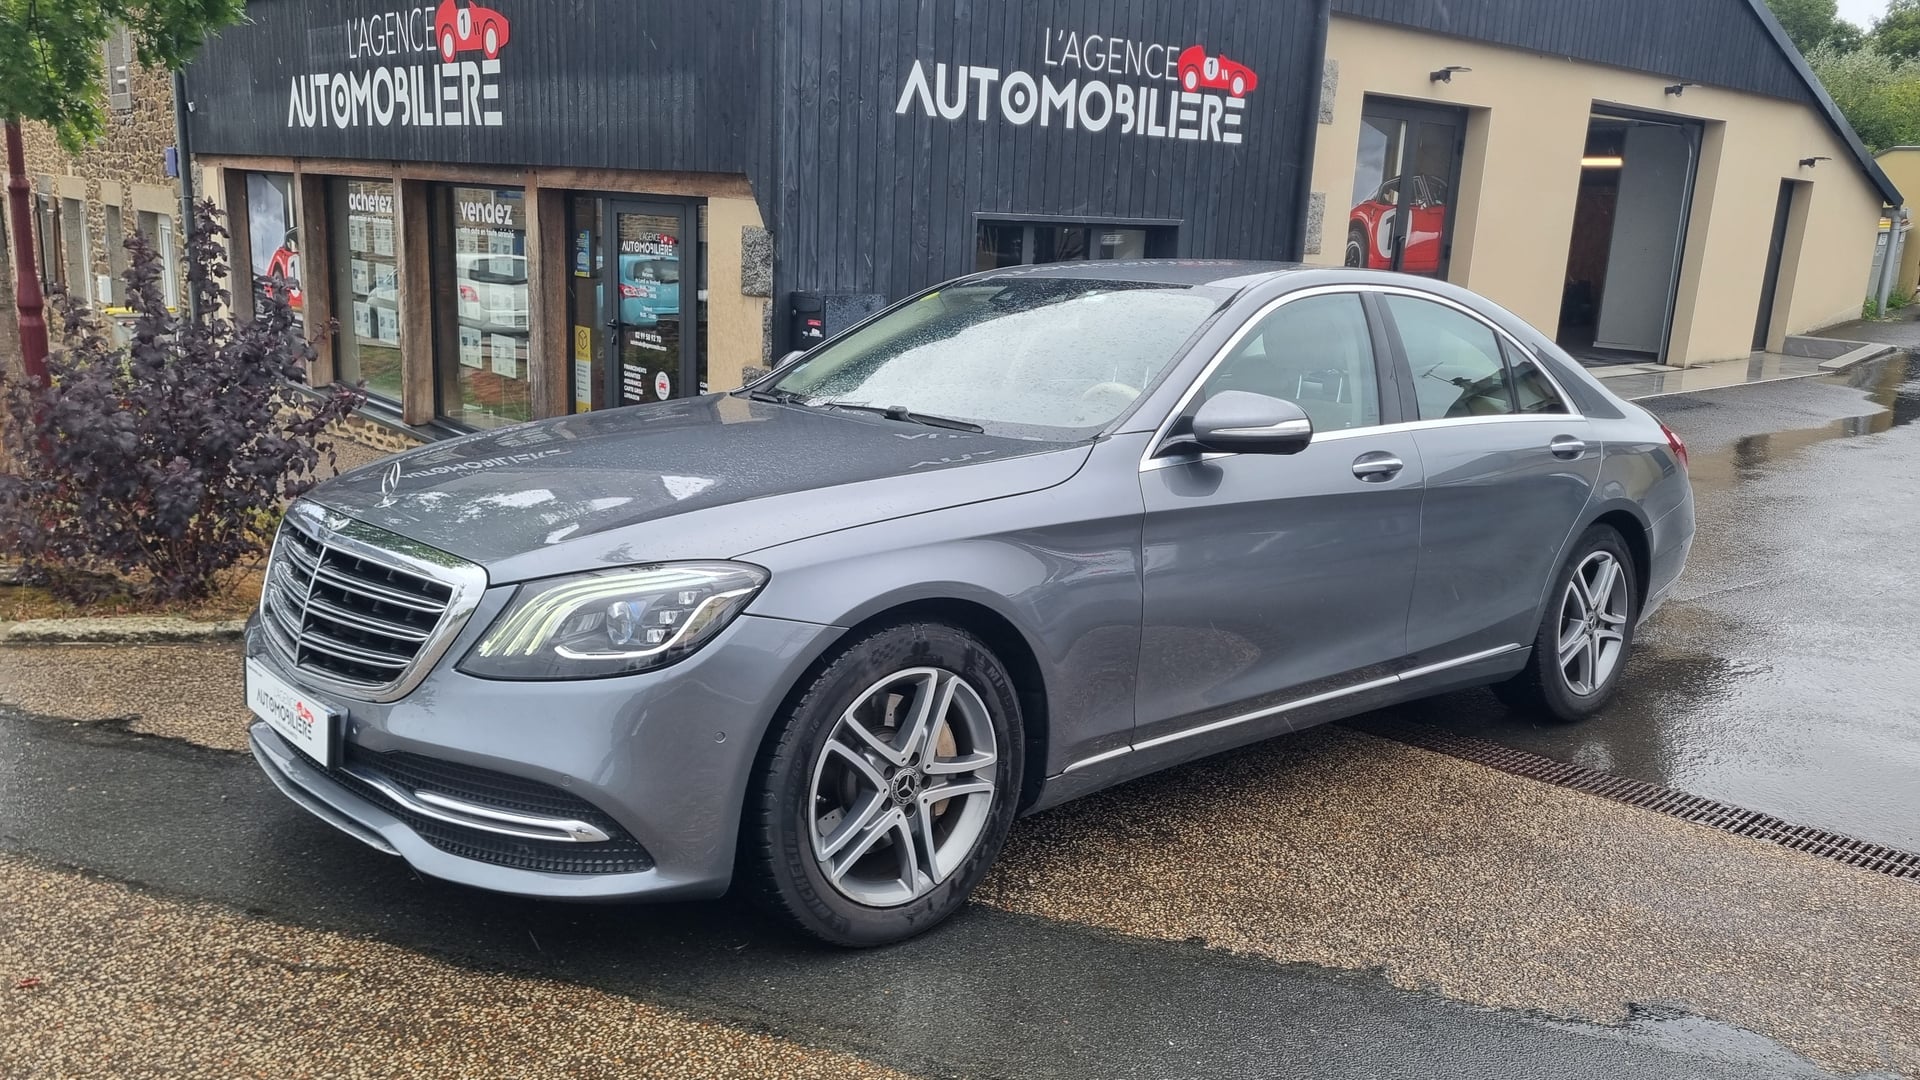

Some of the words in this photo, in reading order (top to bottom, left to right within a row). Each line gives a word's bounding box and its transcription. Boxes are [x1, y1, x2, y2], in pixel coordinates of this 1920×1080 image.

[347, 6, 437, 59] L'AGENCE
[1044, 27, 1180, 81] L'AGENCE
[348, 183, 393, 214] achetez
[459, 190, 513, 226] vendez
